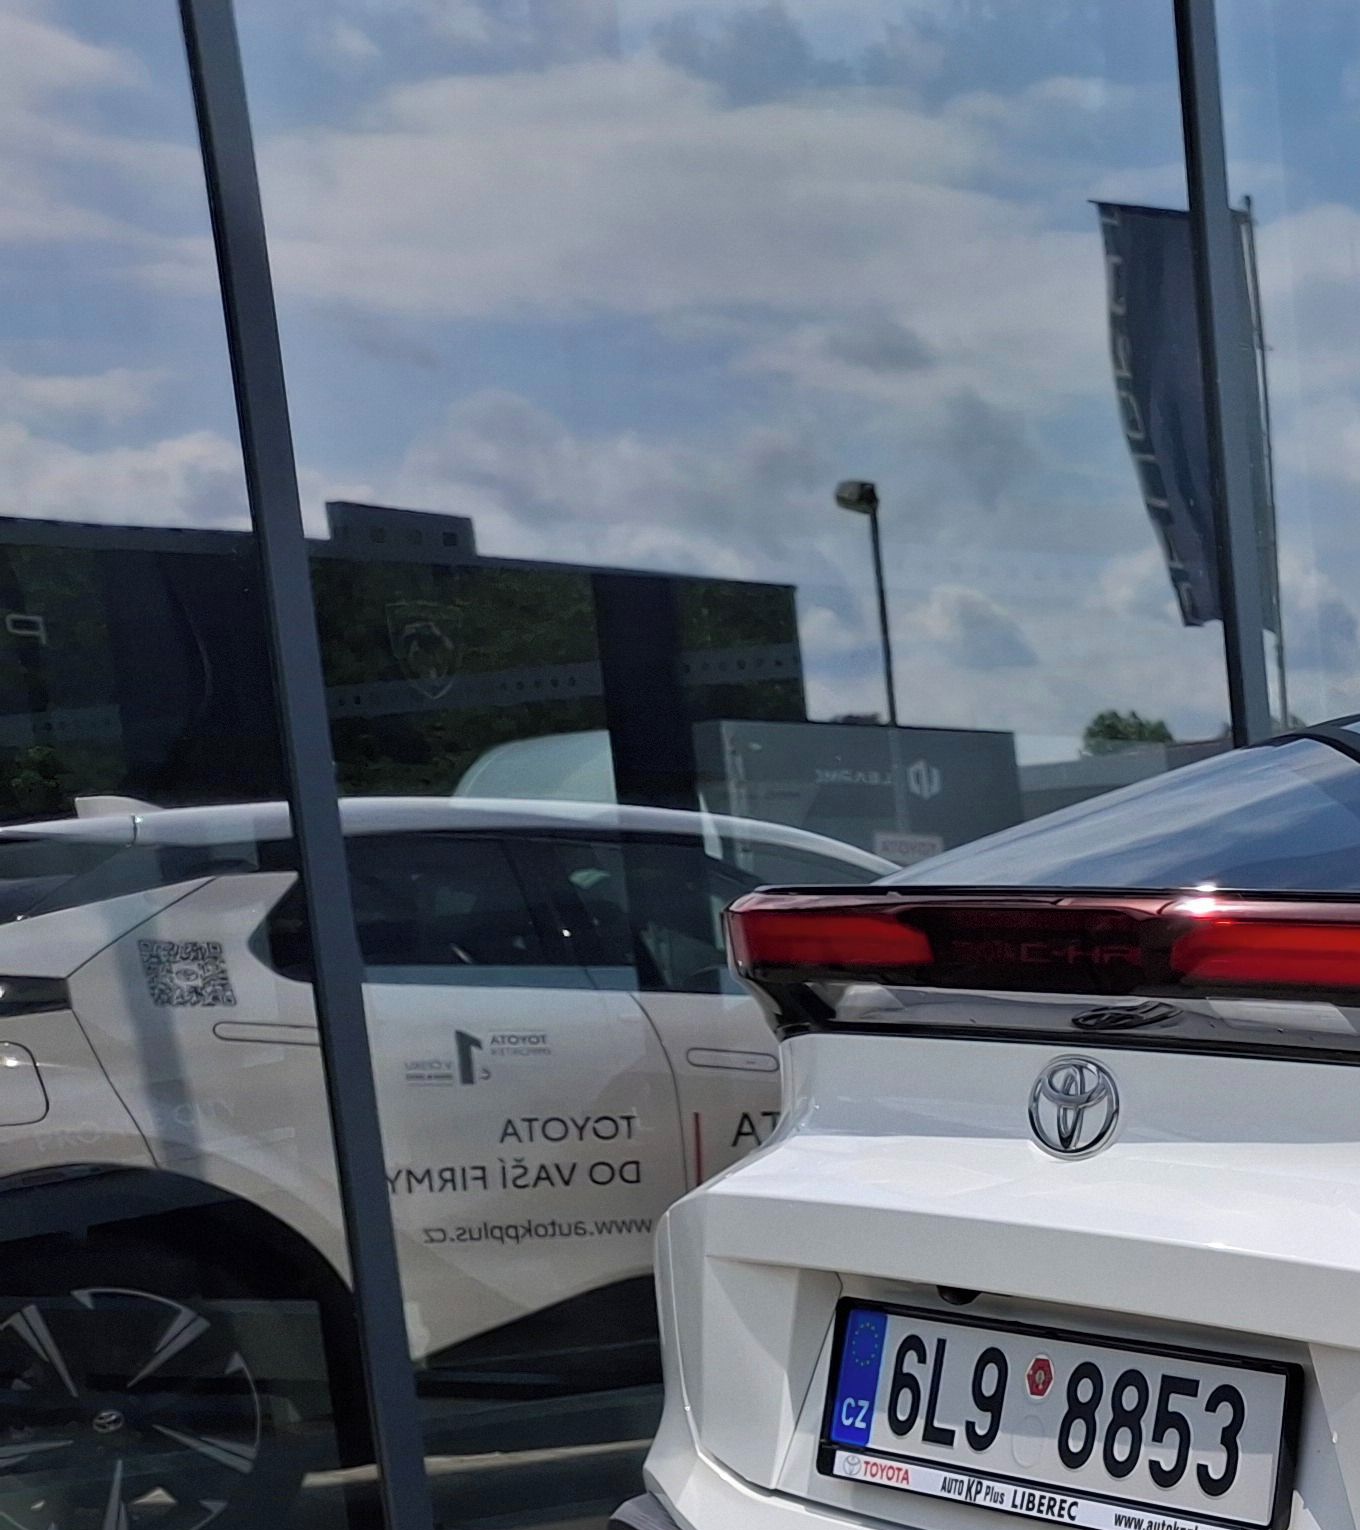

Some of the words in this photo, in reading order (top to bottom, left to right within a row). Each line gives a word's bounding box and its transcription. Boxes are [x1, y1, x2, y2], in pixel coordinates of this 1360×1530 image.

[841, 1396, 868, 1429] CZ
[886, 1333, 1009, 1452] 6L9
[1058, 1361, 1246, 1497] 8853
[863, 1459, 911, 1486] TOYOTA
[940, 1475, 964, 1497] AUTO
[964, 1477, 983, 1504] KP
[984, 1484, 1005, 1506] Plus
[1011, 1488, 1079, 1522] LIBEREC
